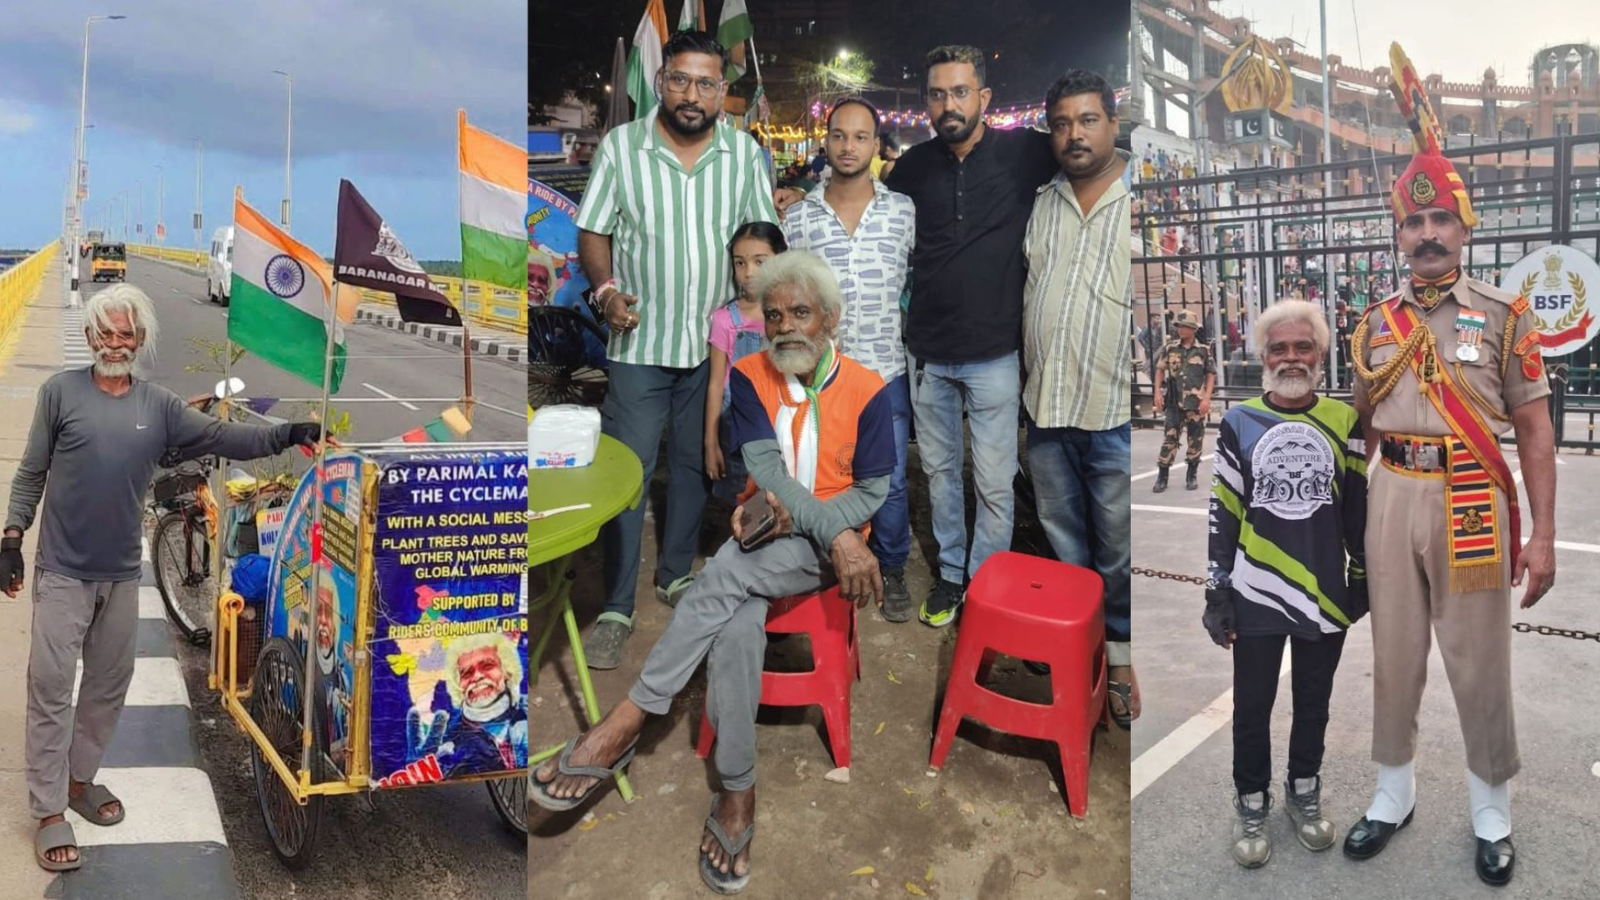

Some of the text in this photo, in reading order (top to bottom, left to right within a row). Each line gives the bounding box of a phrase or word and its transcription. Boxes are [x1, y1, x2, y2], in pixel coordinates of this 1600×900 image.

[535, 186, 556, 204] RIDE
[555, 197, 568, 211] BY
[338, 265, 426, 288] BARANAGAR
[1534, 294, 1572, 310] BSF
[1267, 454, 1322, 464] ADVENTURE
[388, 464, 528, 484] BY PARIMAL KA
[411, 486, 528, 504] THE CYCLEMA
[387, 516, 423, 529] WITH
[426, 515, 436, 527] A
[439, 513, 489, 526] SOCIAL
[382, 537, 425, 550] PLANT
[428, 535, 468, 548] TREES
[471, 534, 497, 546] AND
[400, 552, 453, 565] MOTHER
[456, 549, 506, 561] NATURE
[415, 562, 528, 579] GLOBAL WARMING
[432, 593, 516, 611] SUPPORTED BY
[388, 623, 431, 640] RIDERS
[434, 620, 498, 637] COMMUNITY
[502, 619, 516, 632] OF
